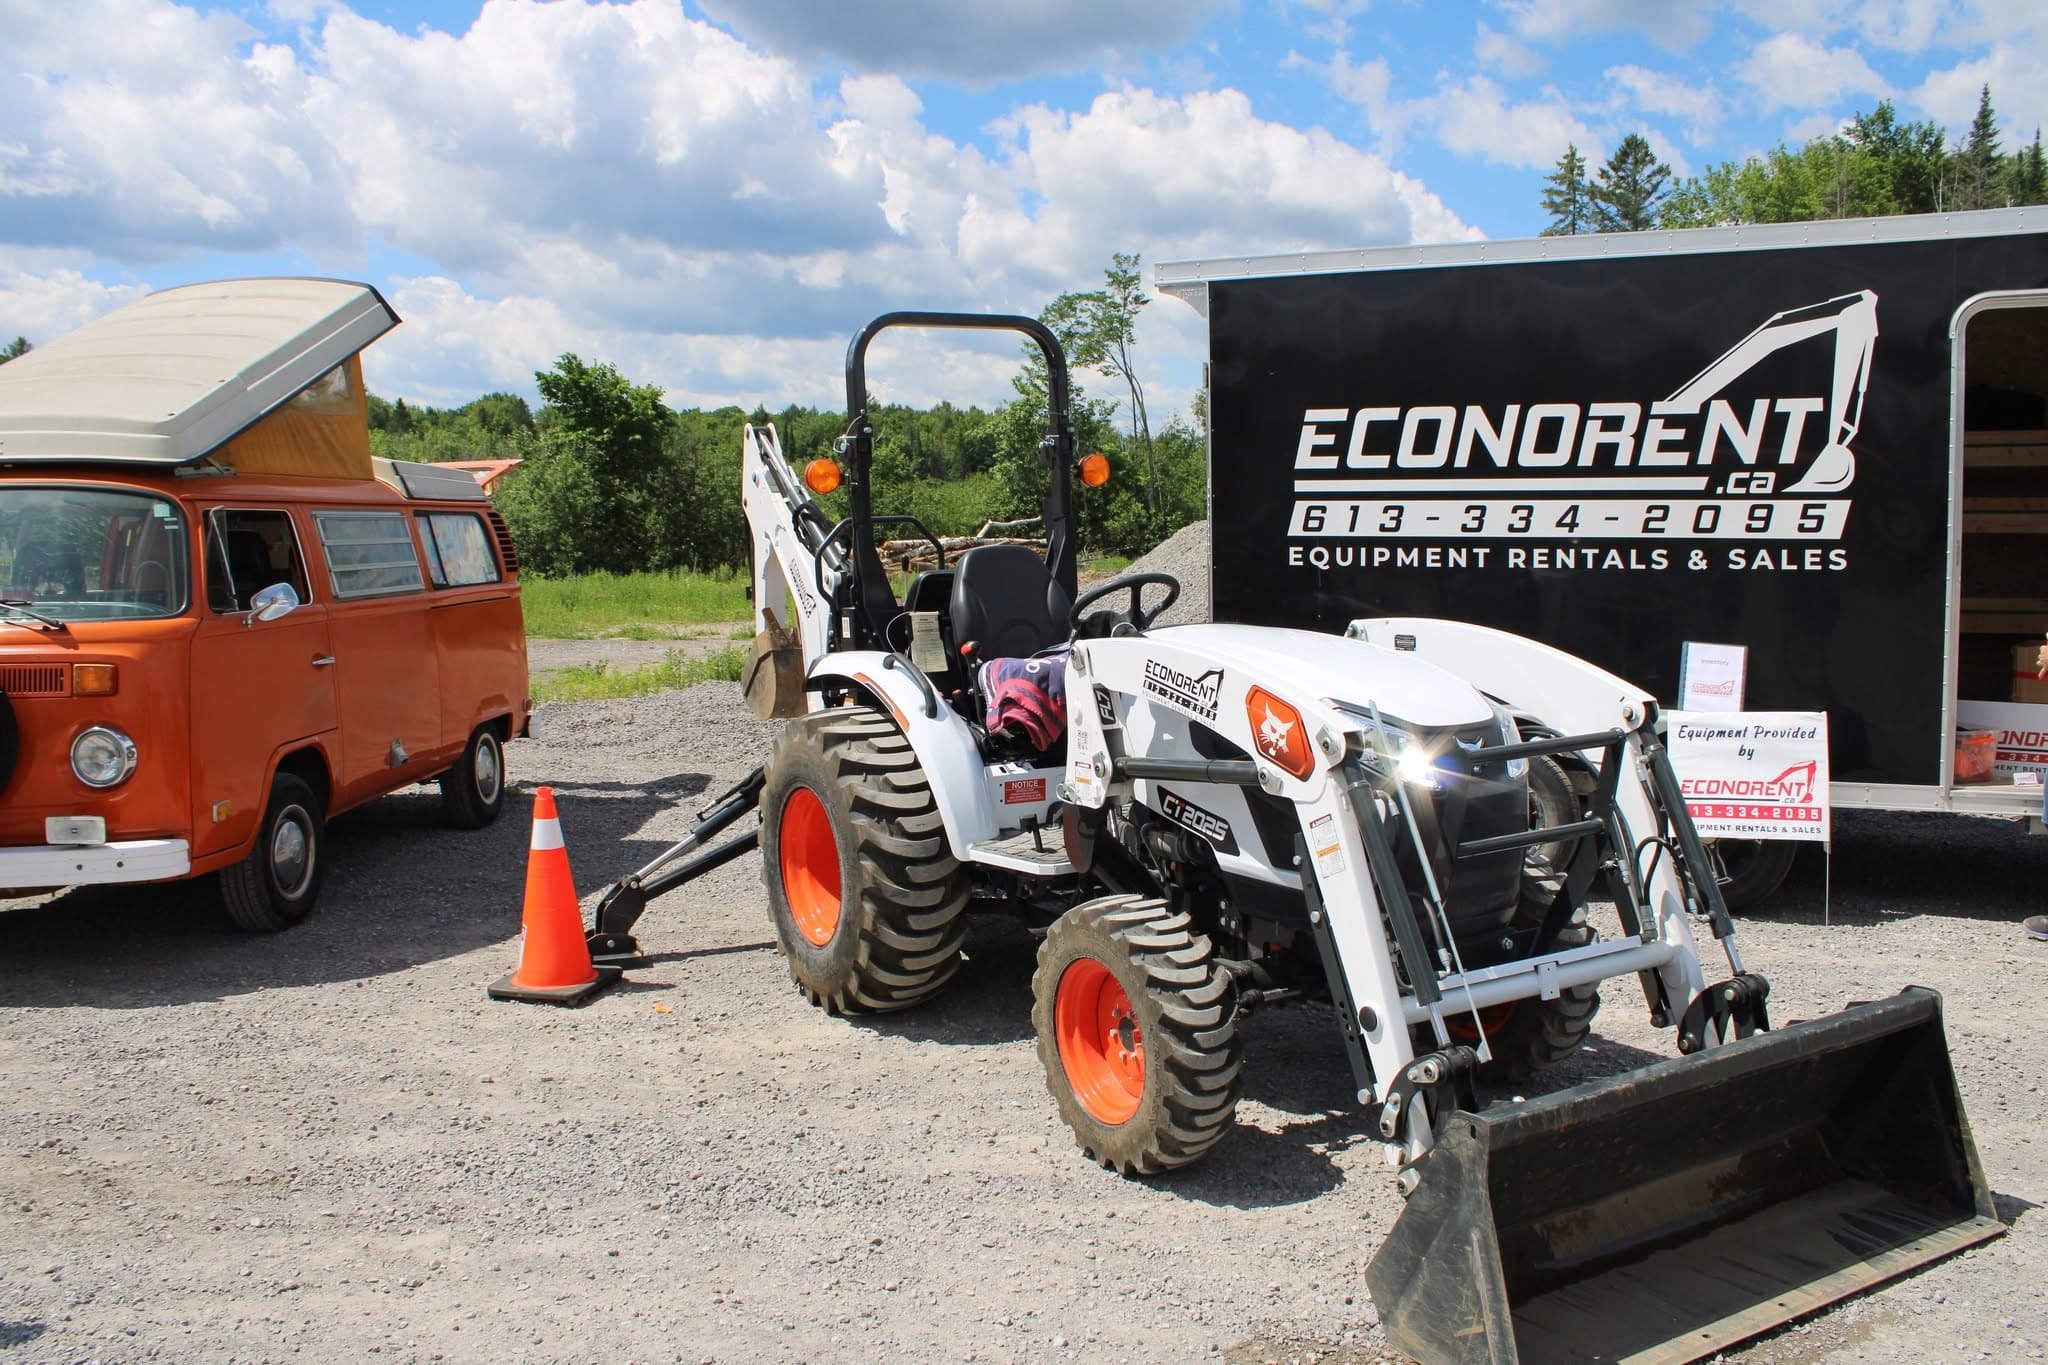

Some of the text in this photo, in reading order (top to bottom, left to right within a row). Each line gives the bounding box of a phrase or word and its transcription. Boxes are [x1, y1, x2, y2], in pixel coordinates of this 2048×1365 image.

[1294, 397, 1825, 470] ECONORENT
[1714, 471, 1776, 495] .ca
[1302, 503, 1829, 535] 613-334-2095
[1287, 546, 1849, 572] EQUIPMENT RENTALS & SALES
[1145, 659, 1216, 702] ECONORENT
[1097, 690, 1114, 721] FL7
[1678, 725, 1817, 741] Equipment Provided
[1738, 745, 1755, 760] by
[1012, 780, 1039, 789] NOTICE
[1680, 779, 1805, 797] ECONORENT
[1163, 795, 1228, 841] CT2025
[1692, 805, 1819, 820] 13-334-2095
[1735, 825, 1777, 833] RENTALS
[1792, 826, 1822, 834] SALES
